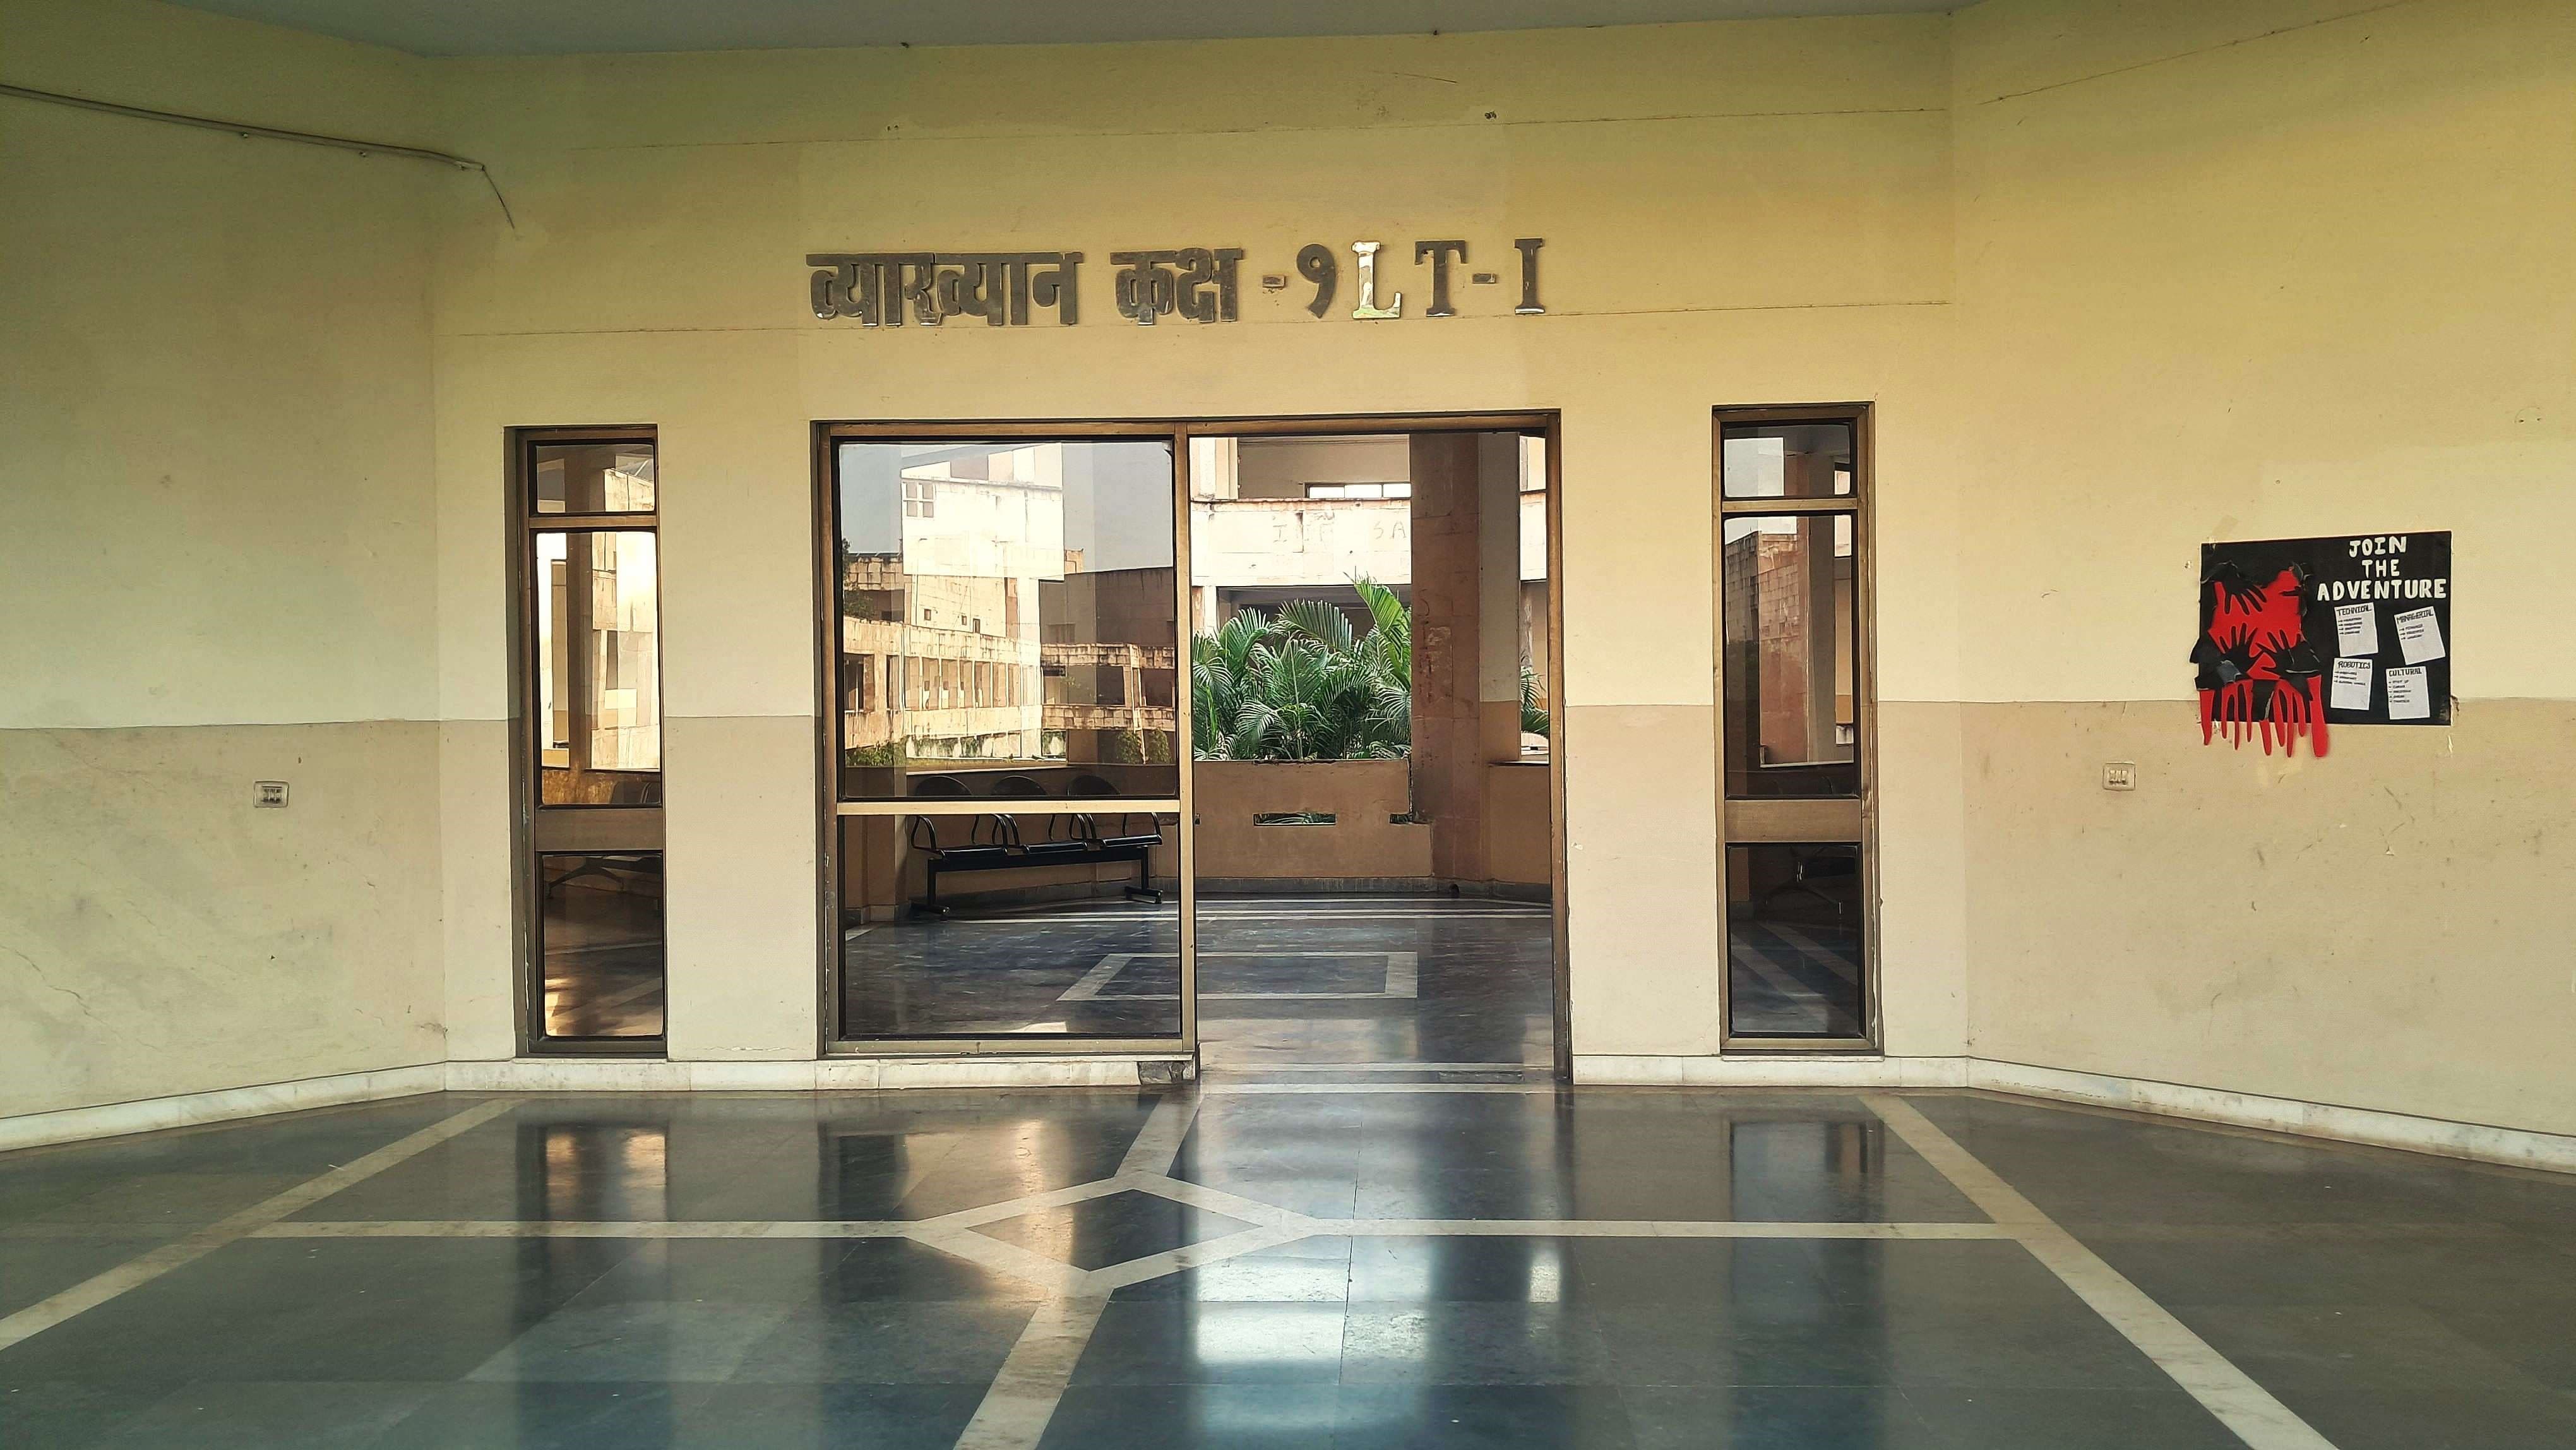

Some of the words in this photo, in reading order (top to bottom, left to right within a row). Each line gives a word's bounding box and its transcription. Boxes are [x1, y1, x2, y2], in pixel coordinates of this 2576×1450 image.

[1110, 247, 1244, 325] कक्ष
[2349, 536, 2407, 558] JOIN
[2361, 559, 2400, 578] THE
[2317, 578, 2447, 601] ADVENTURE
[2336, 604, 2372, 616] TECHNICAL
[2338, 661, 2371, 669] ROBOTICS
[2388, 668, 2422, 676] CULTURAL
